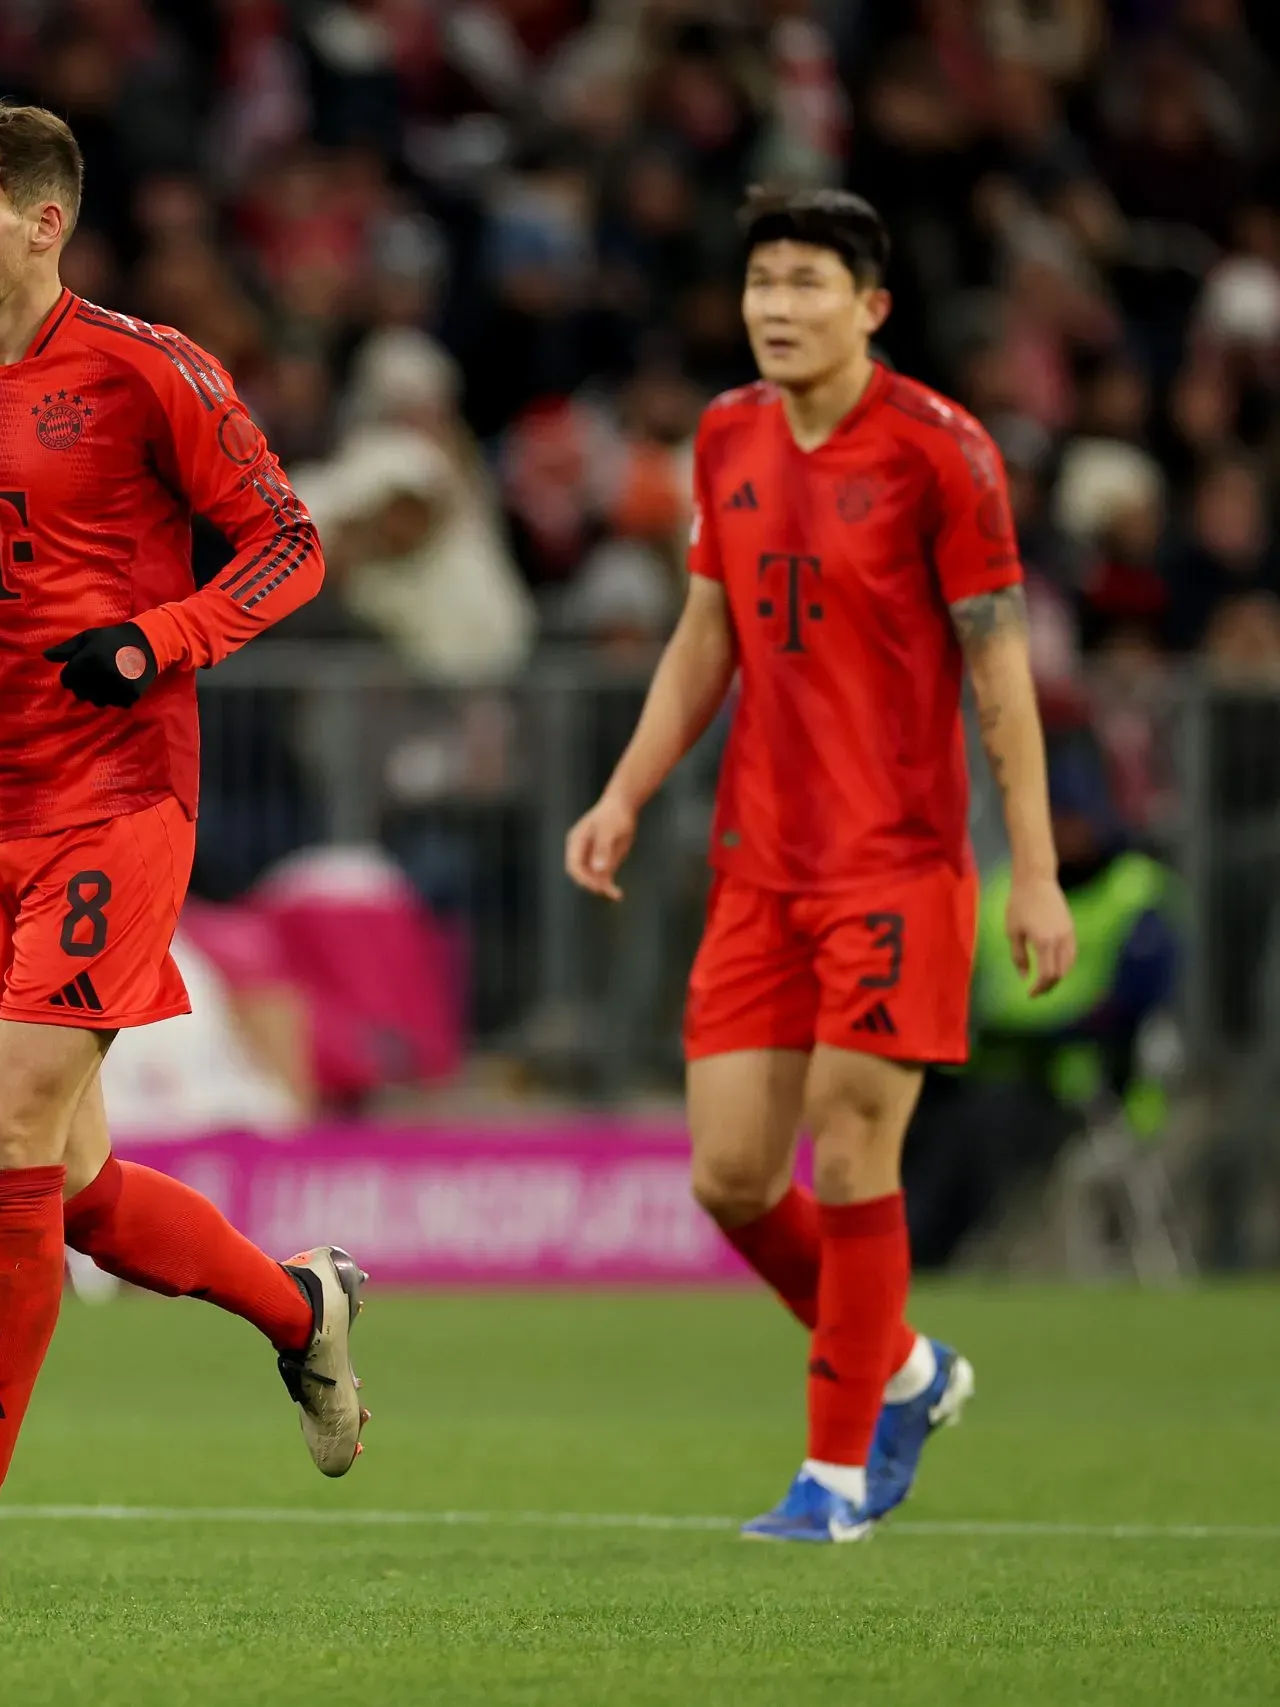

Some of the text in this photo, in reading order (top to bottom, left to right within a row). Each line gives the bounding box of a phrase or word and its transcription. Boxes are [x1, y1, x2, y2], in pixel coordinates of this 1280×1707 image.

[51, 407, 80, 424] BAYERN
[758, 553, 823, 652] T
[60, 870, 112, 957] 8
[859, 912, 904, 988] 3
